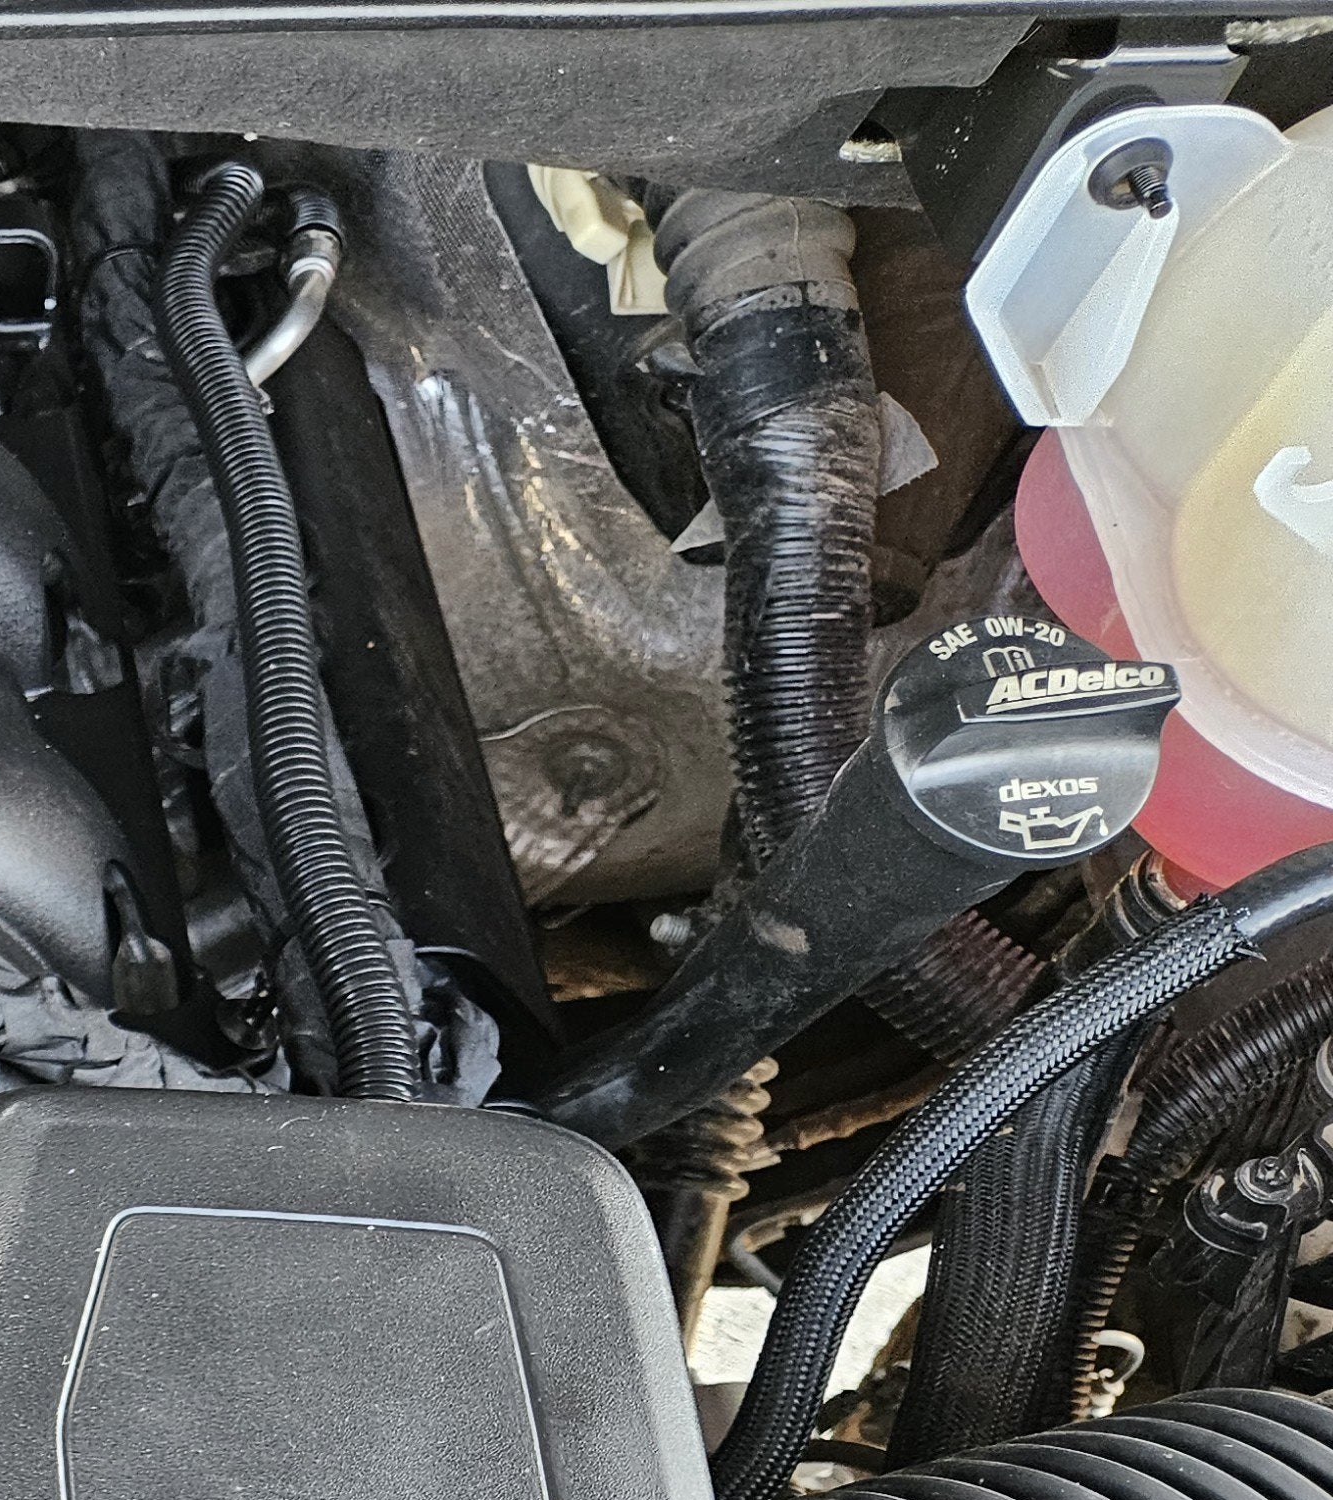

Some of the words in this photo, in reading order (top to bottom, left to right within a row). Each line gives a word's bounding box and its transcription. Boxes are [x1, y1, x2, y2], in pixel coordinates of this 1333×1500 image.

[929, 623, 978, 661] SAE
[984, 617, 1066, 647] 0W-20
[986, 663, 1165, 705] ACDelco
[999, 777, 1098, 803] dexos
